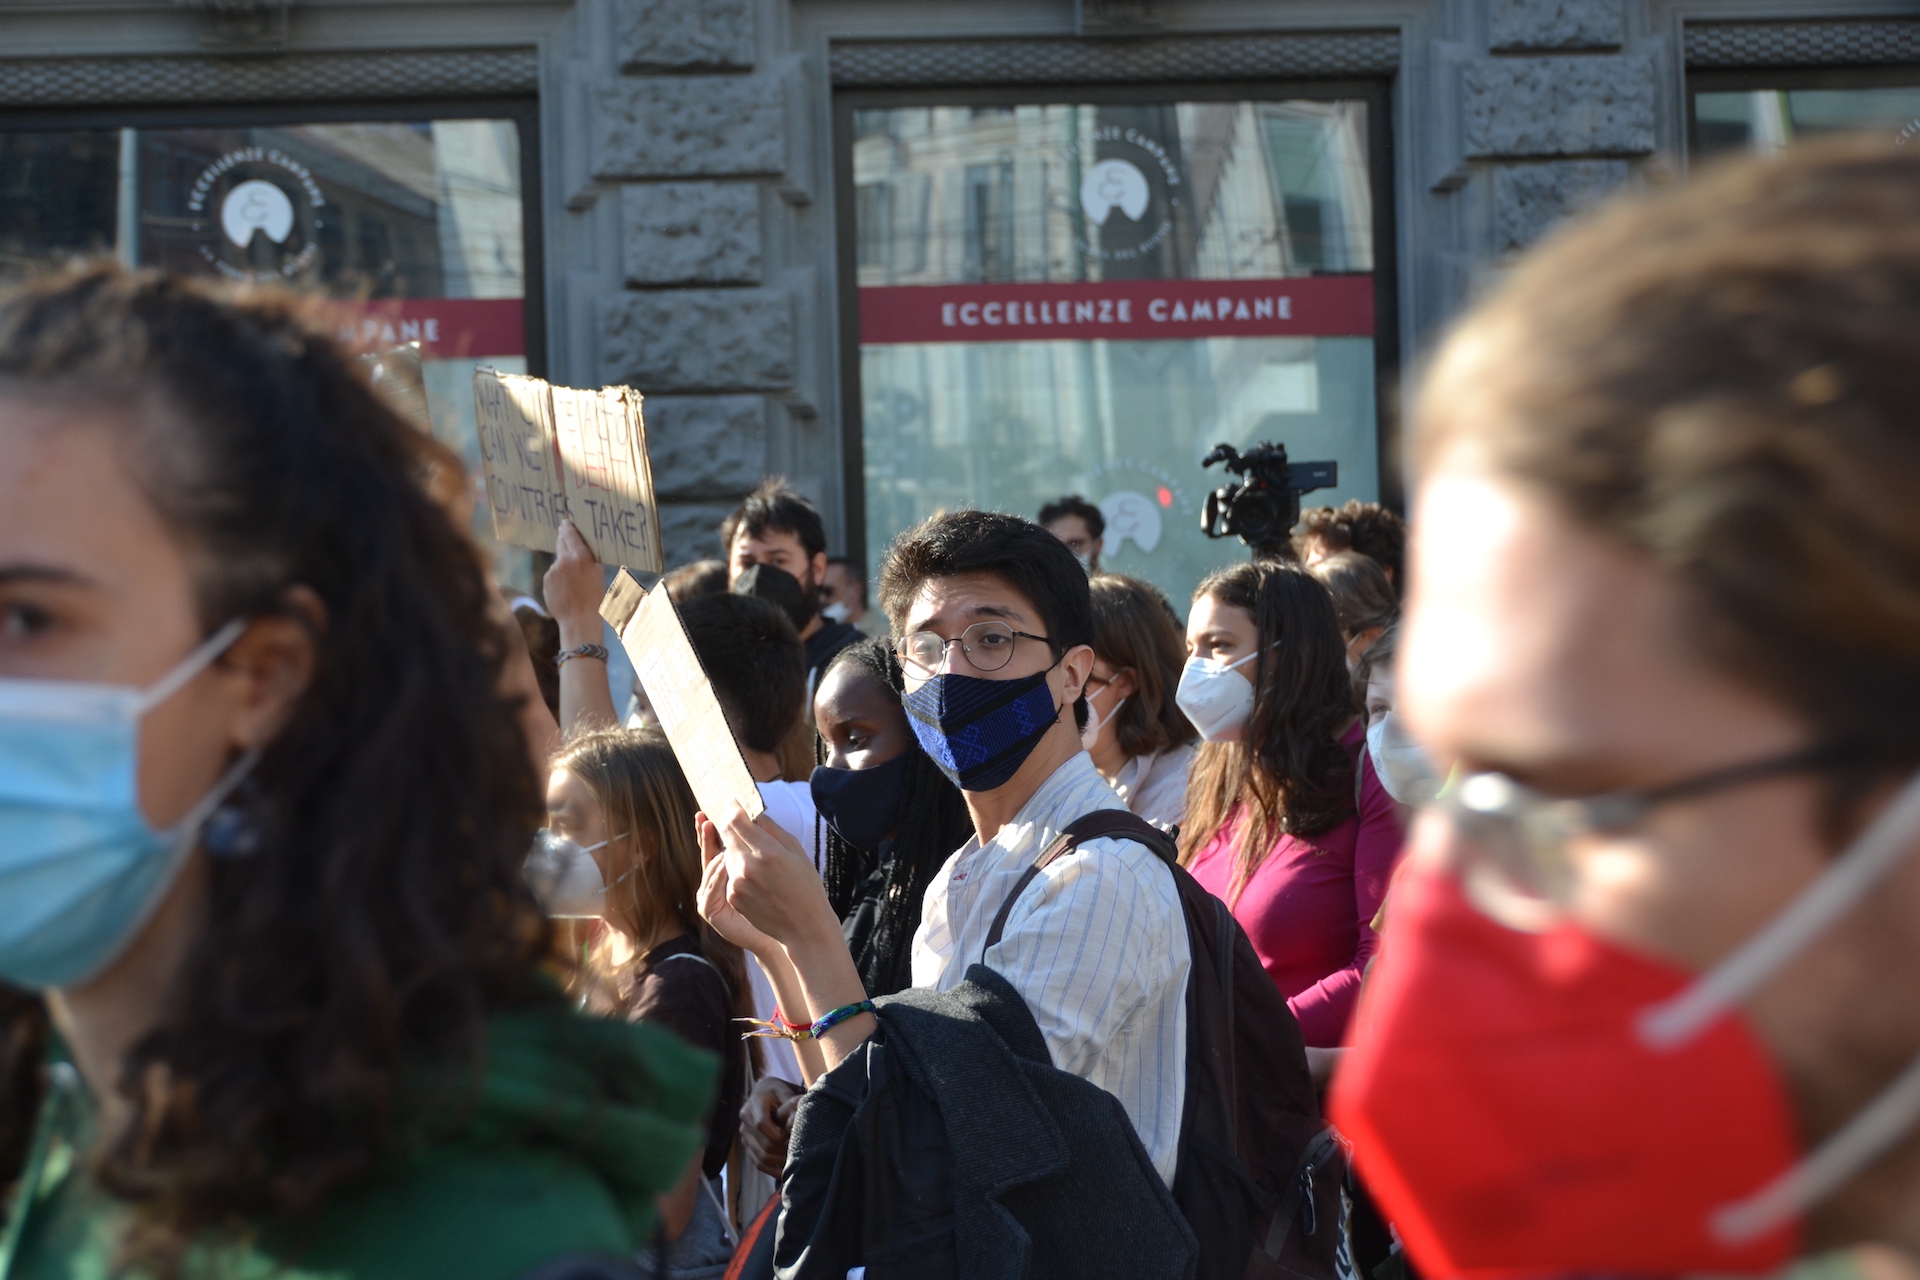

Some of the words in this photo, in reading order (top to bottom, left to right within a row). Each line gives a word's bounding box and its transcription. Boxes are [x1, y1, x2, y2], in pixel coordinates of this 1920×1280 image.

[941, 301, 1133, 327] ECCELLENZE
[1148, 296, 1293, 322] CAMPANE
[338, 317, 440, 343] MPANE
[584, 497, 648, 552] TAKE?
